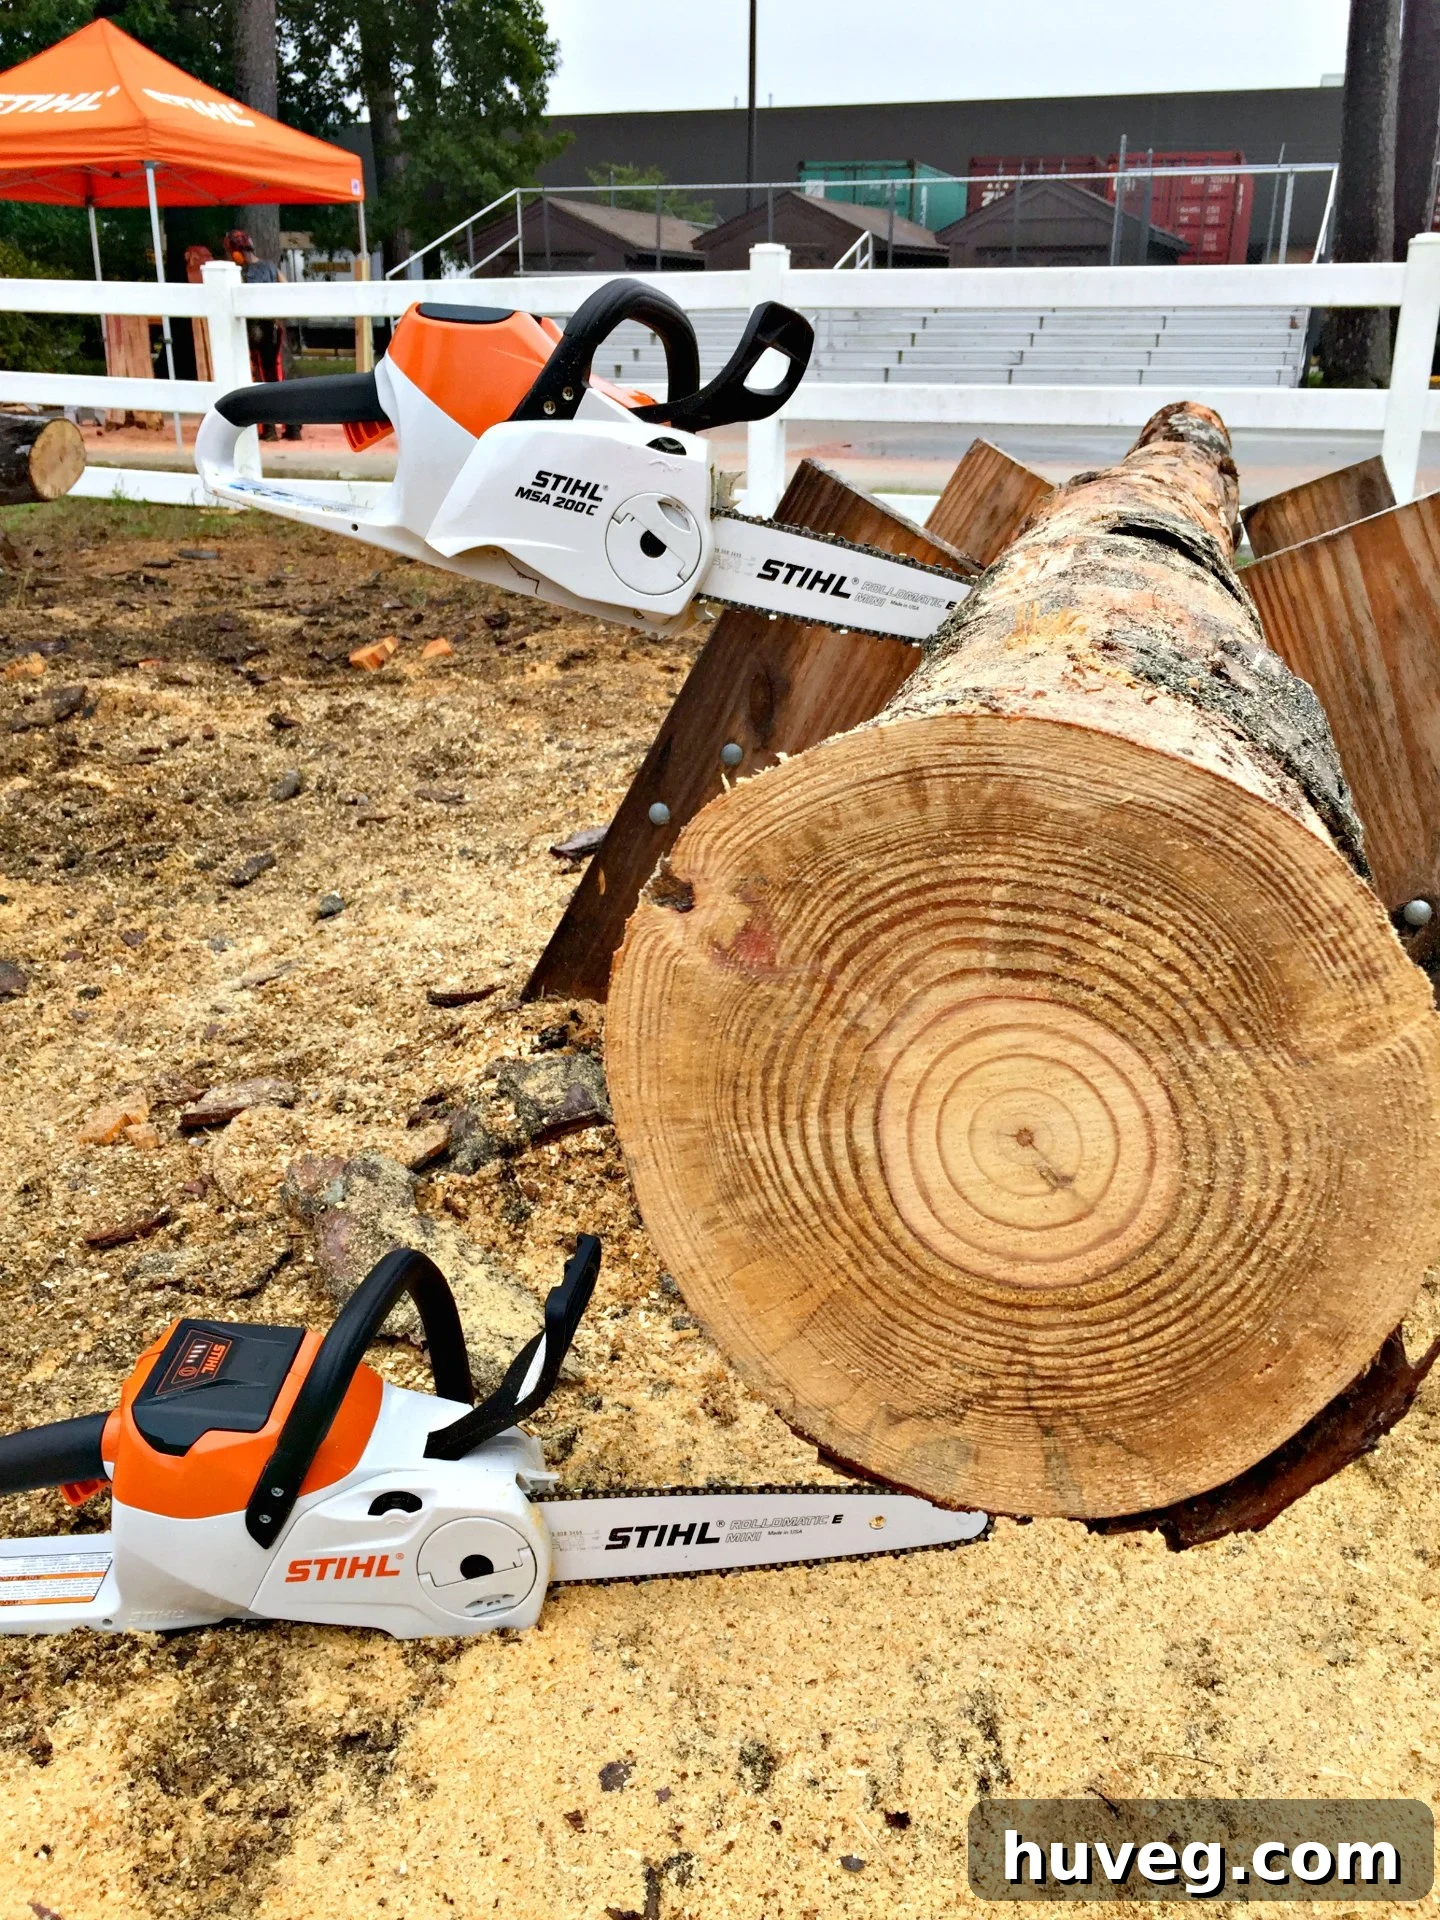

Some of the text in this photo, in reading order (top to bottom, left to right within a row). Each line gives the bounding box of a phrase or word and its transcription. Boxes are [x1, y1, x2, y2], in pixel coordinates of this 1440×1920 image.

[515, 486, 550, 505] MSA
[854, 592, 887, 608] MINI
[861, 581, 946, 609] ROLLOMATIC
[200, 1344, 226, 1375] STIHL
[730, 1514, 844, 1530] ROLLOMATIC E
[725, 1531, 762, 1543] MINI
